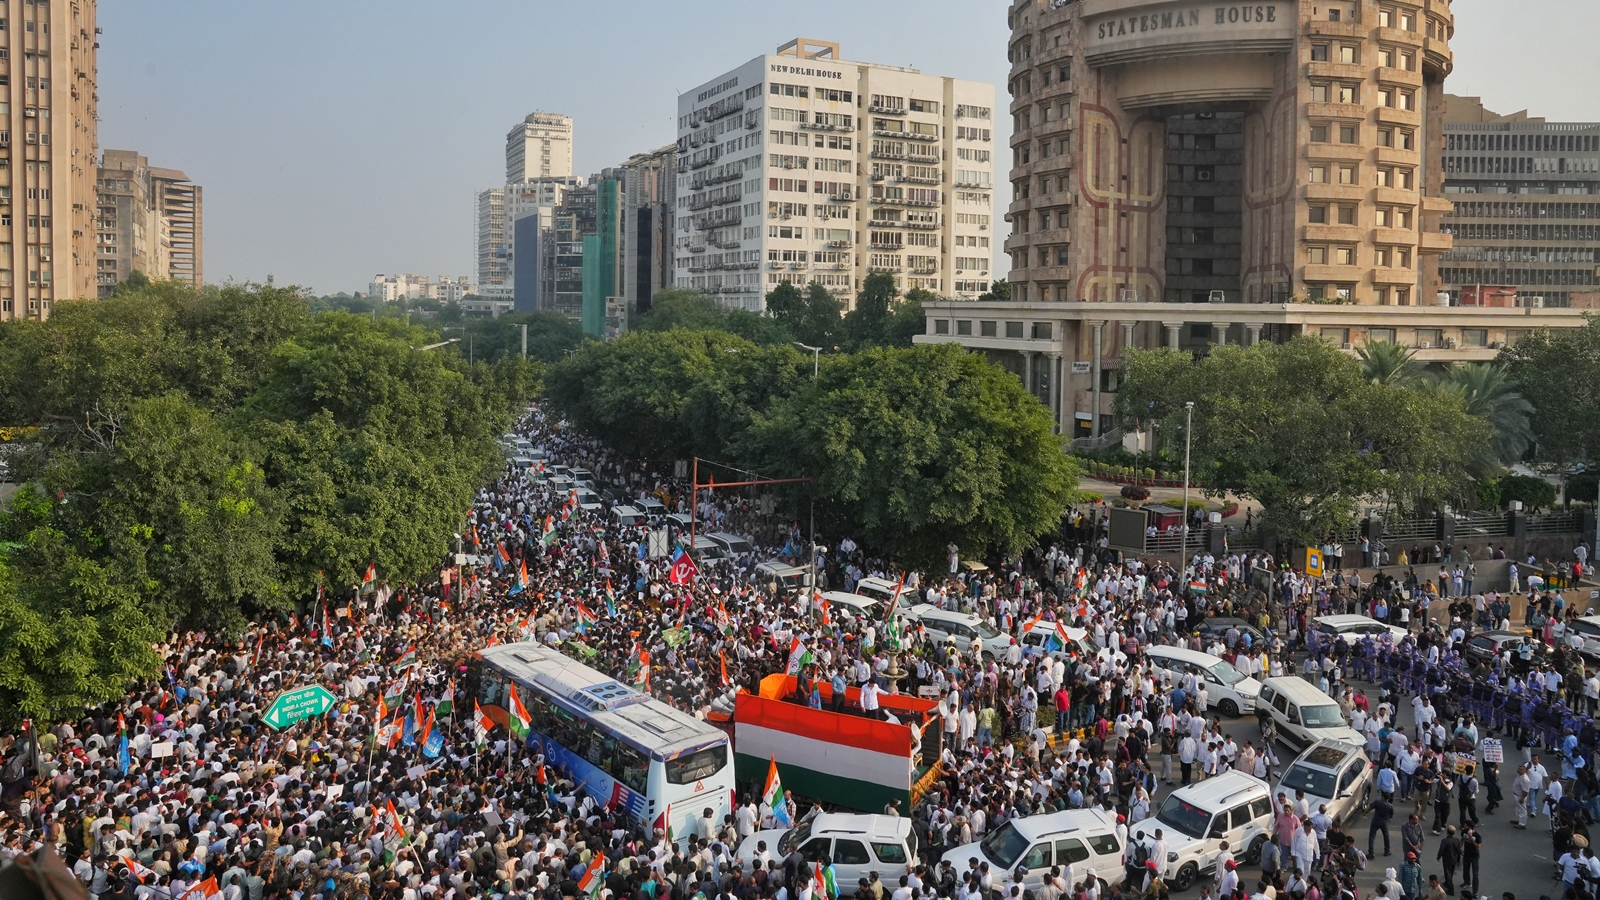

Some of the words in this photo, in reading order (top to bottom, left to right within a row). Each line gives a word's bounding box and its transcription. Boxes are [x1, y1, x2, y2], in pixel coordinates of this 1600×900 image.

[1098, 9, 1200, 39] STATESMAN
[1214, 5, 1277, 25] HOUSE
[770, 64, 788, 73] NEW
[789, 66, 815, 77] DELHI
[816, 69, 842, 80] HOUSE
[698, 91, 708, 103] NEW
[707, 84, 722, 99] DELHI
[722, 77, 738, 92] HOUSE
[281, 703, 300, 713] INDIRA
[300, 698, 319, 708] CHOWK
